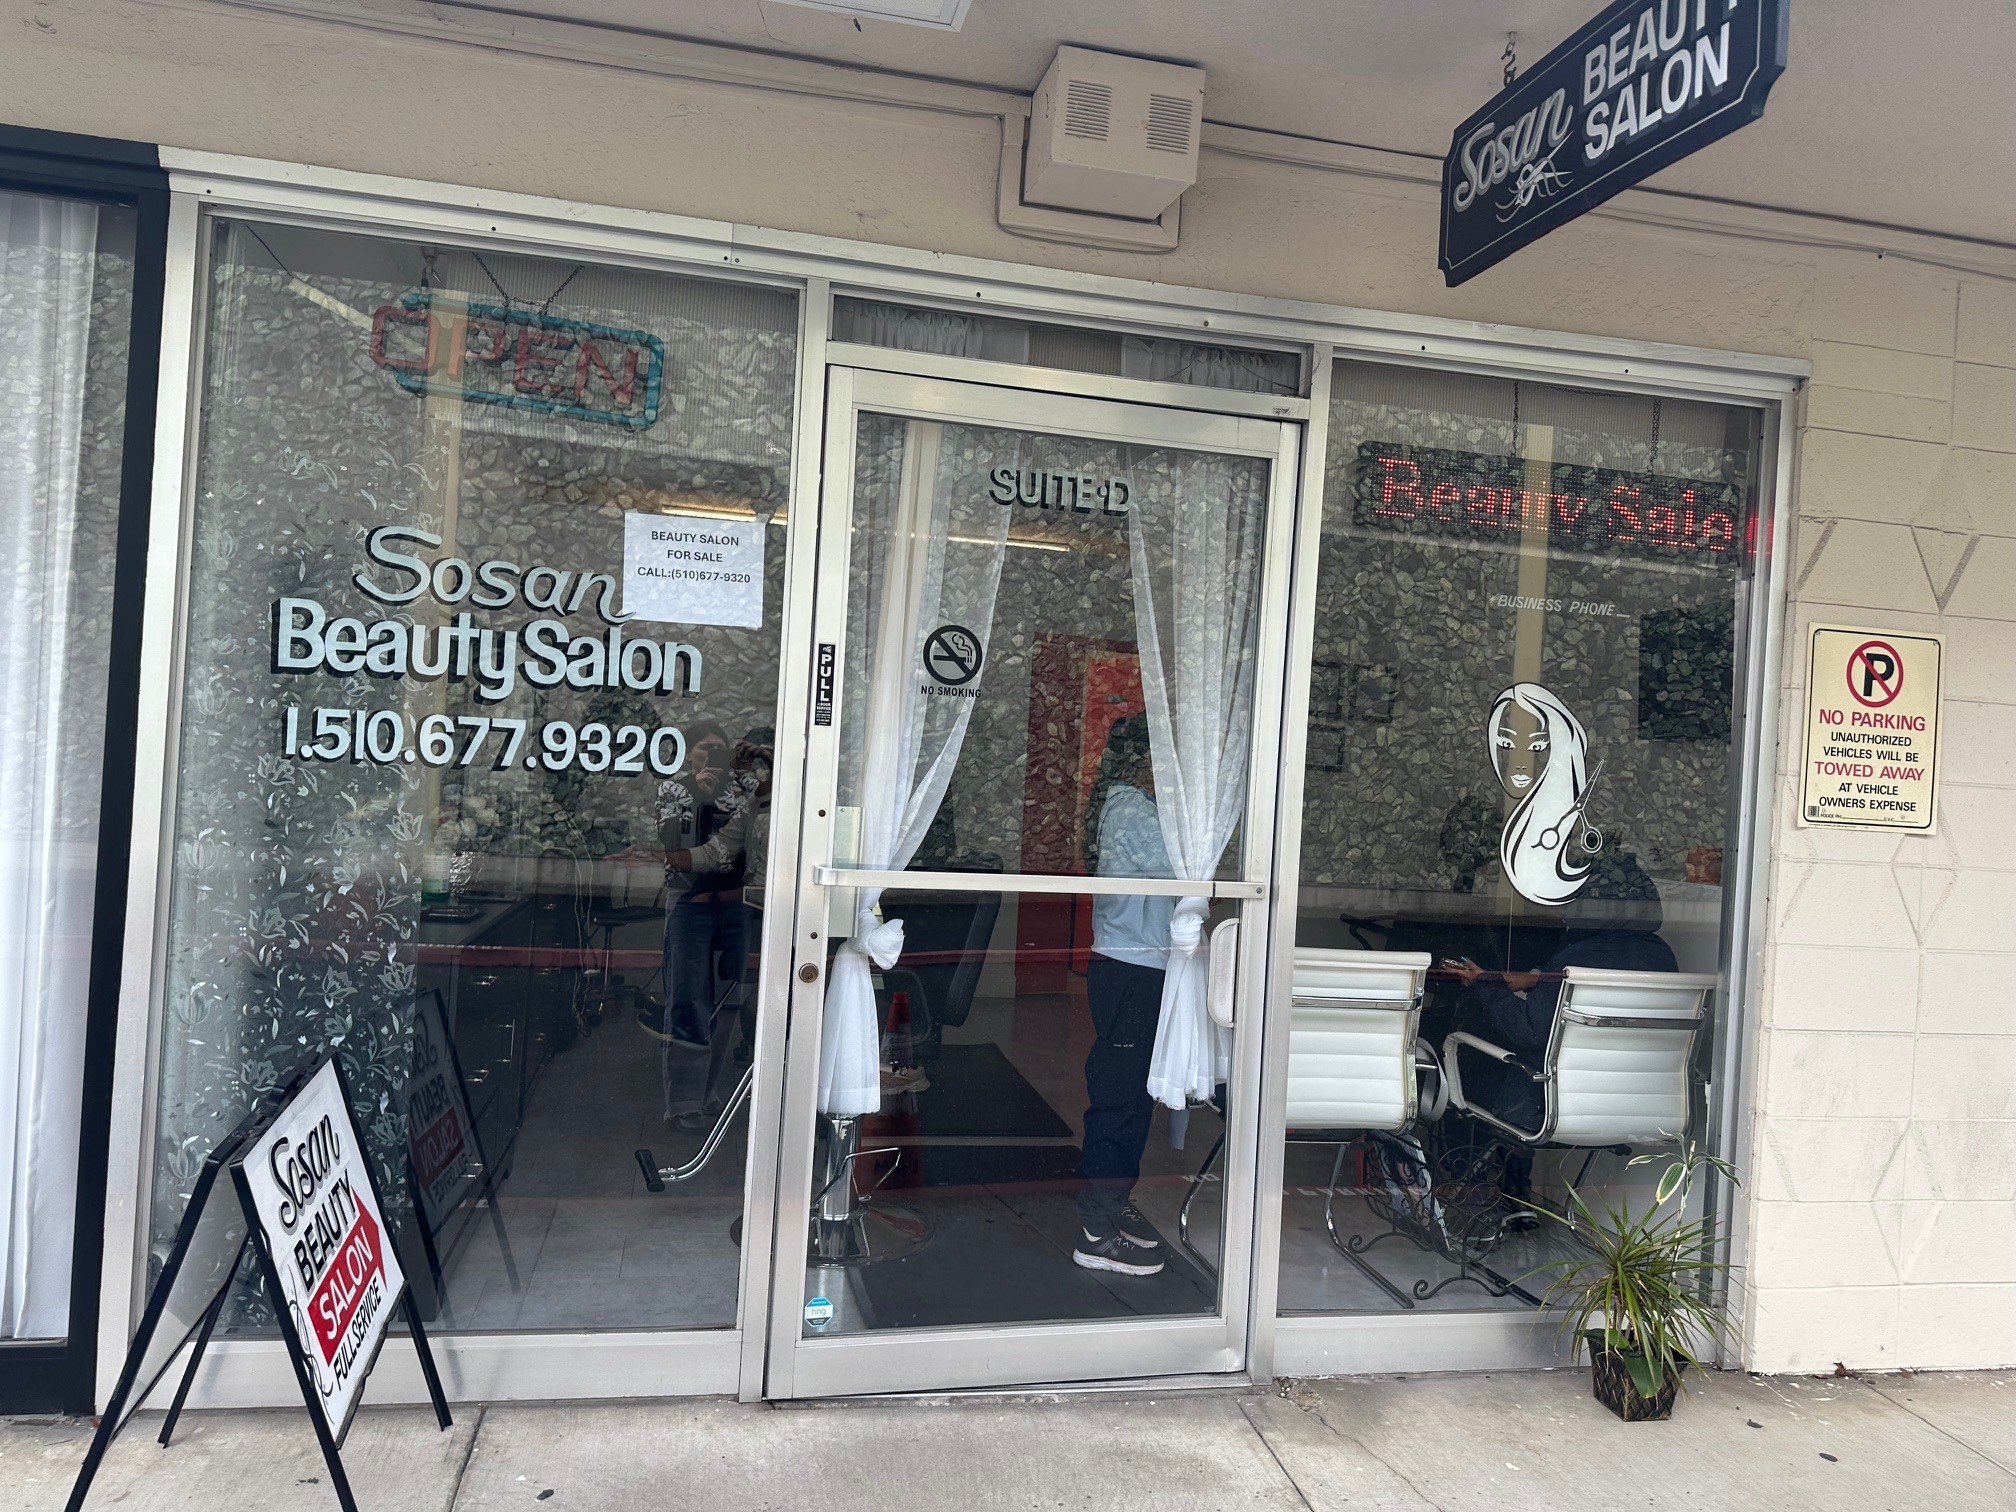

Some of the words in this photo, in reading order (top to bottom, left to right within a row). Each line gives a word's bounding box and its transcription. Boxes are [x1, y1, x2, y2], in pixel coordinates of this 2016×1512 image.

[1585, 23, 1730, 160] SALON
[1455, 87, 1574, 210] Sosan
[370, 306, 640, 404] OPEN
[651, 531, 697, 543] BEAUTY
[699, 534, 739, 546] SALON
[667, 550, 691, 560] FOR
[694, 552, 723, 563] SALE
[353, 525, 637, 625] Sosan
[637, 567, 751, 583] CALL:(510)677-9320
[1498, 594, 1562, 612] BUSINESS
[1569, 601, 1616, 616] PHONE
[820, 653, 832, 702] PULL
[921, 685, 934, 694] NO
[937, 686, 982, 698] SMOKING
[1819, 709, 1844, 725] NO
[1851, 711, 1926, 731] PARKING
[1831, 731, 1912, 747] UNAUTHORIZED
[1823, 746, 1872, 760] VEHICLES
[1876, 750, 1902, 761] WILL
[1905, 752, 1919, 763] BE
[1814, 761, 1874, 778] TOWED
[1879, 766, 1925, 781] AWAY
[1838, 782, 1853, 793] AT
[1856, 783, 1899, 796] VEHICLE
[1818, 796, 1866, 809] OWNERS
[1869, 799, 1917, 812] EXPENSE
[268, 1114, 341, 1234] Sosan
[294, 1168, 356, 1293] BEAUTY
[321, 1225, 374, 1340] SALON
[811, 1308, 827, 1316] ring
[333, 1332, 358, 1391] FULL
[351, 1275, 382, 1349] SERVICE
